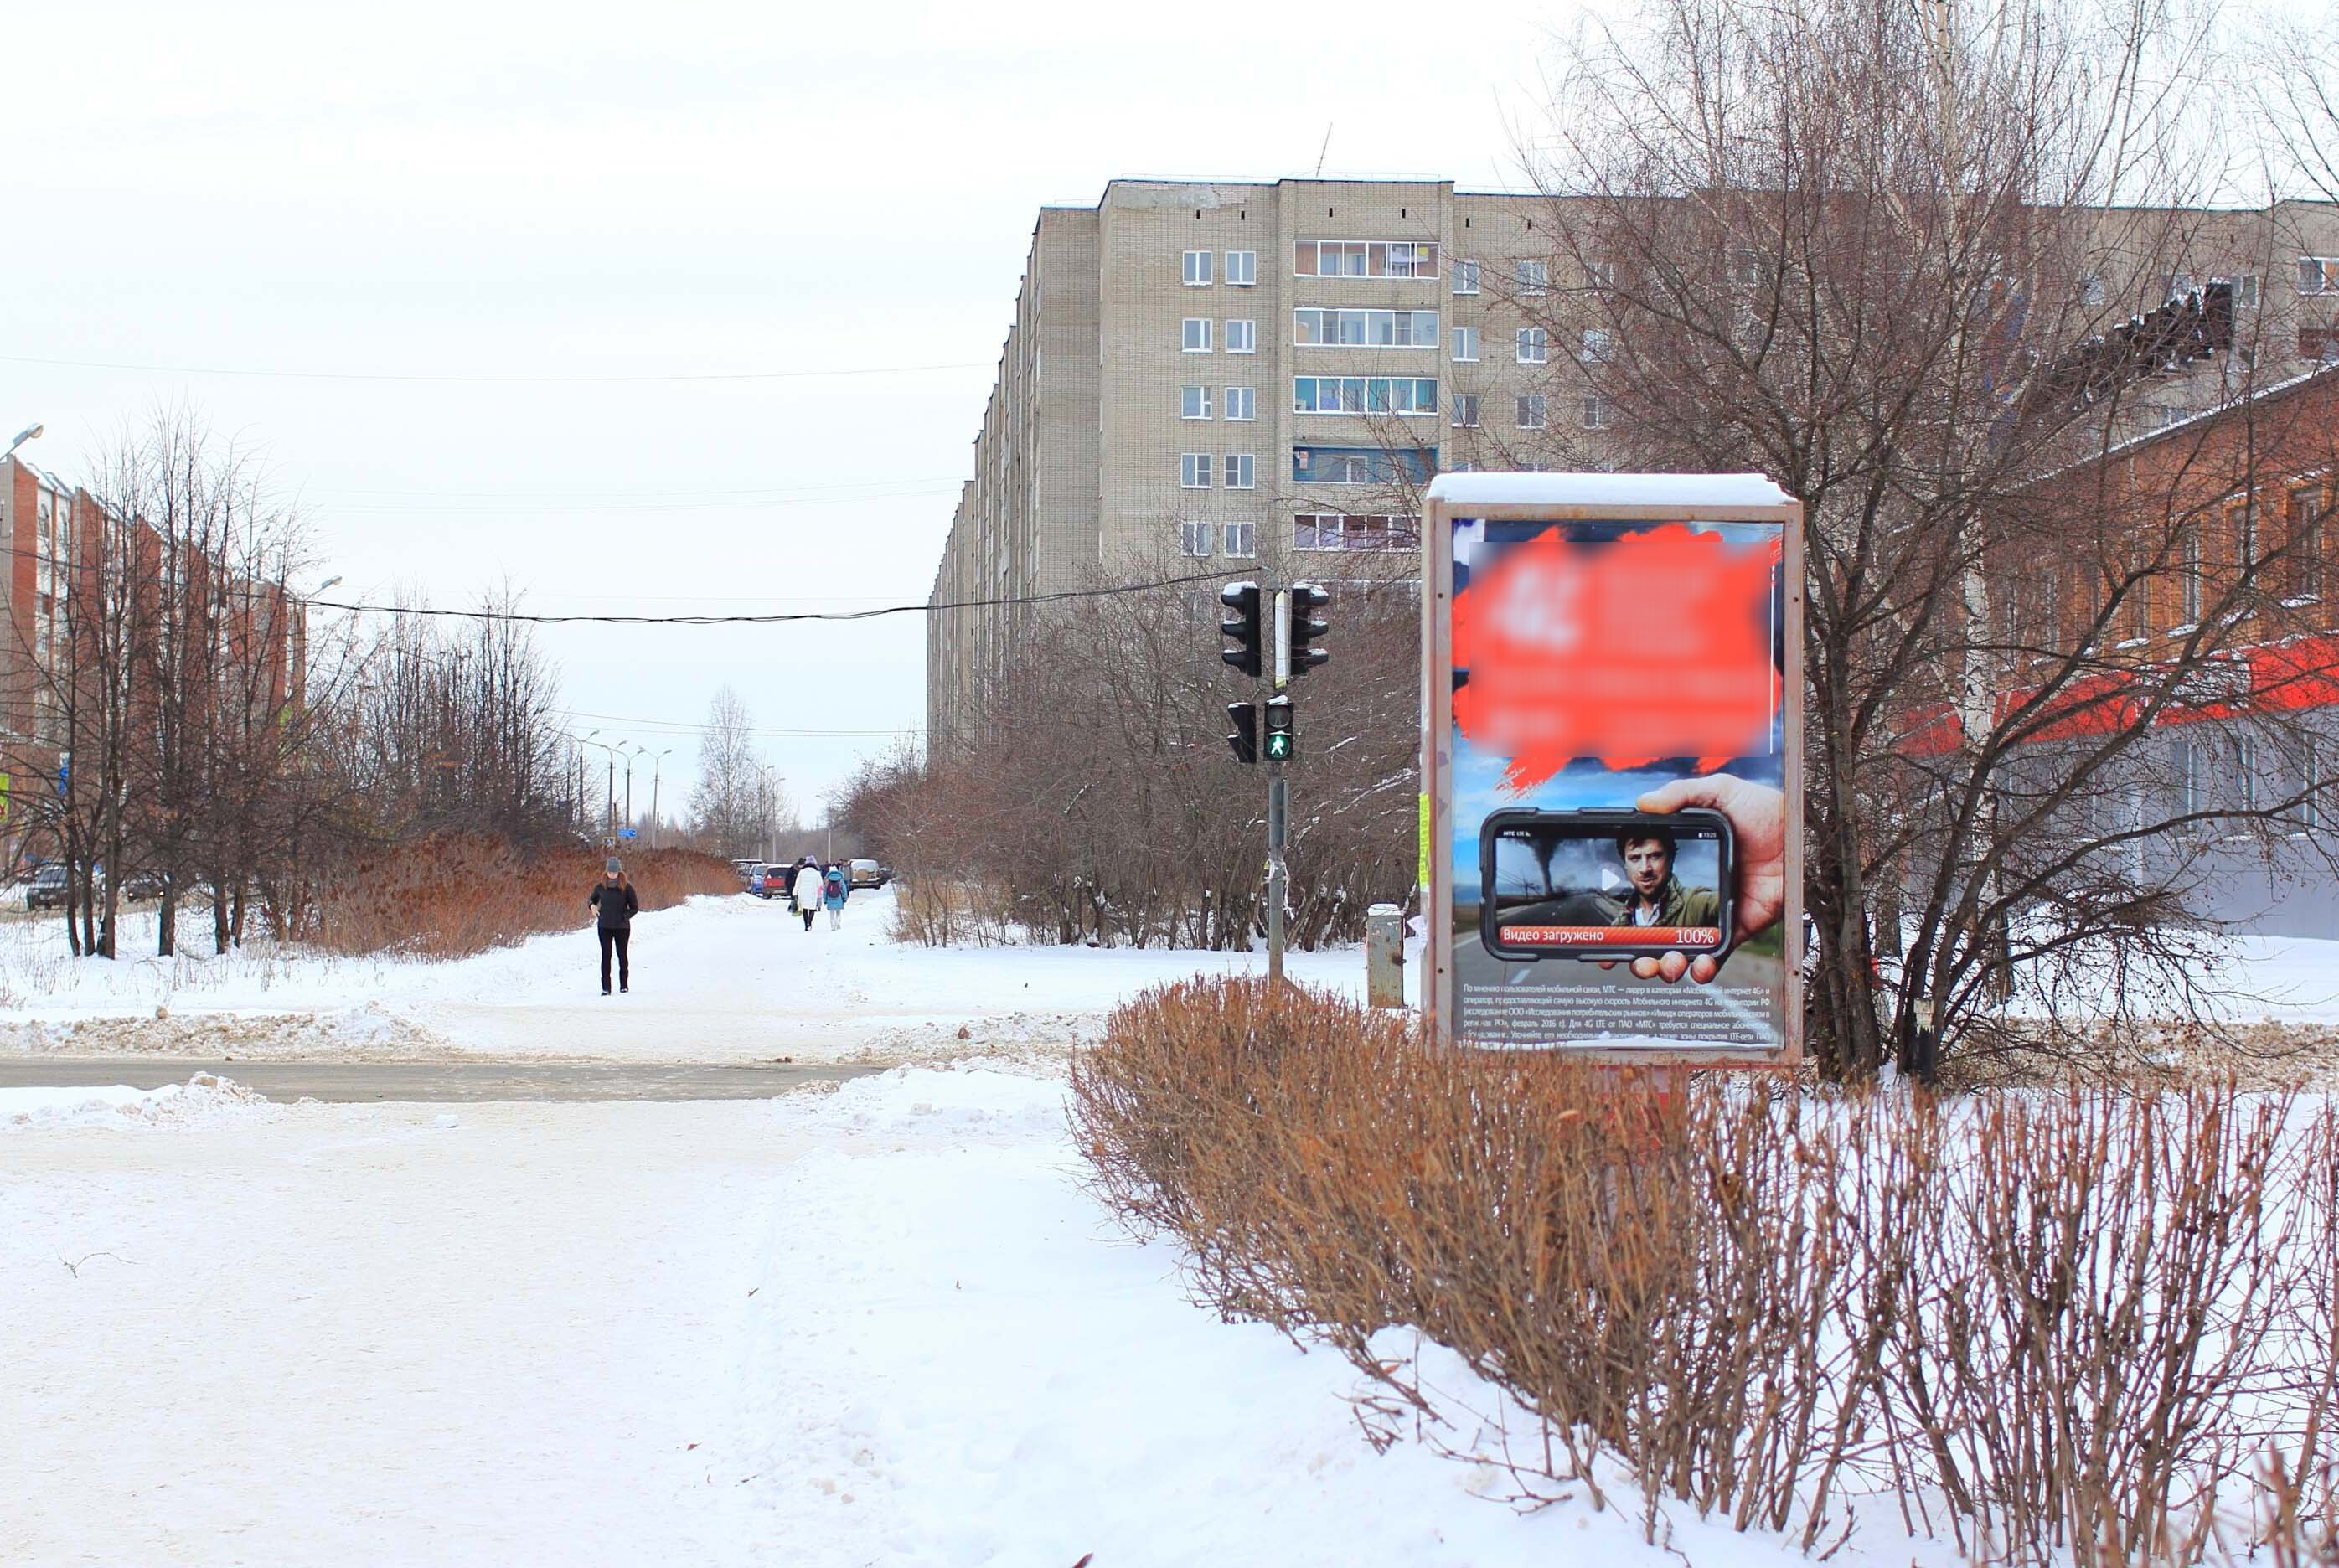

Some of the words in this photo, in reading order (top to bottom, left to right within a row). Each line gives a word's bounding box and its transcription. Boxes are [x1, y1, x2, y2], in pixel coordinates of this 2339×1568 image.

[1503, 928, 1540, 941] Видео
[1542, 931, 1604, 943] загружено
[1676, 929, 1715, 944] 100%
[1464, 983, 1473, 993] По
[1546, 985, 1583, 993] мобильной
[1602, 985, 1616, 993] МТС
[1625, 987, 1645, 995] лидер
[1651, 987, 1681, 995] категории
[1463, 997, 1494, 1005] оператор,
[1553, 998, 1574, 1006] самую
[1632, 997, 1670, 1005] Мобильного
[1671, 998, 1702, 1007] интернета
[1704, 998, 1713, 1006] 4G
[1509, 1007, 1524, 1016] ООО
[1572, 1008, 1622, 1018] потребительских
[1650, 1008, 1676, 1018] «Имидж
[1511, 1019, 1539, 1029] февраль
[1541, 1019, 1557, 1028] 2016
[1568, 1019, 1582, 1029] Для
[1583, 1019, 1593, 1028] 4G
[1595, 1019, 1606, 1028] LTE
[1618, 1019, 1633, 1028] ПАО
[1635, 1019, 1655, 1029] «МТС»
[1659, 1020, 1688, 1030] требуется
[1691, 1022, 1729, 1030] специальное
